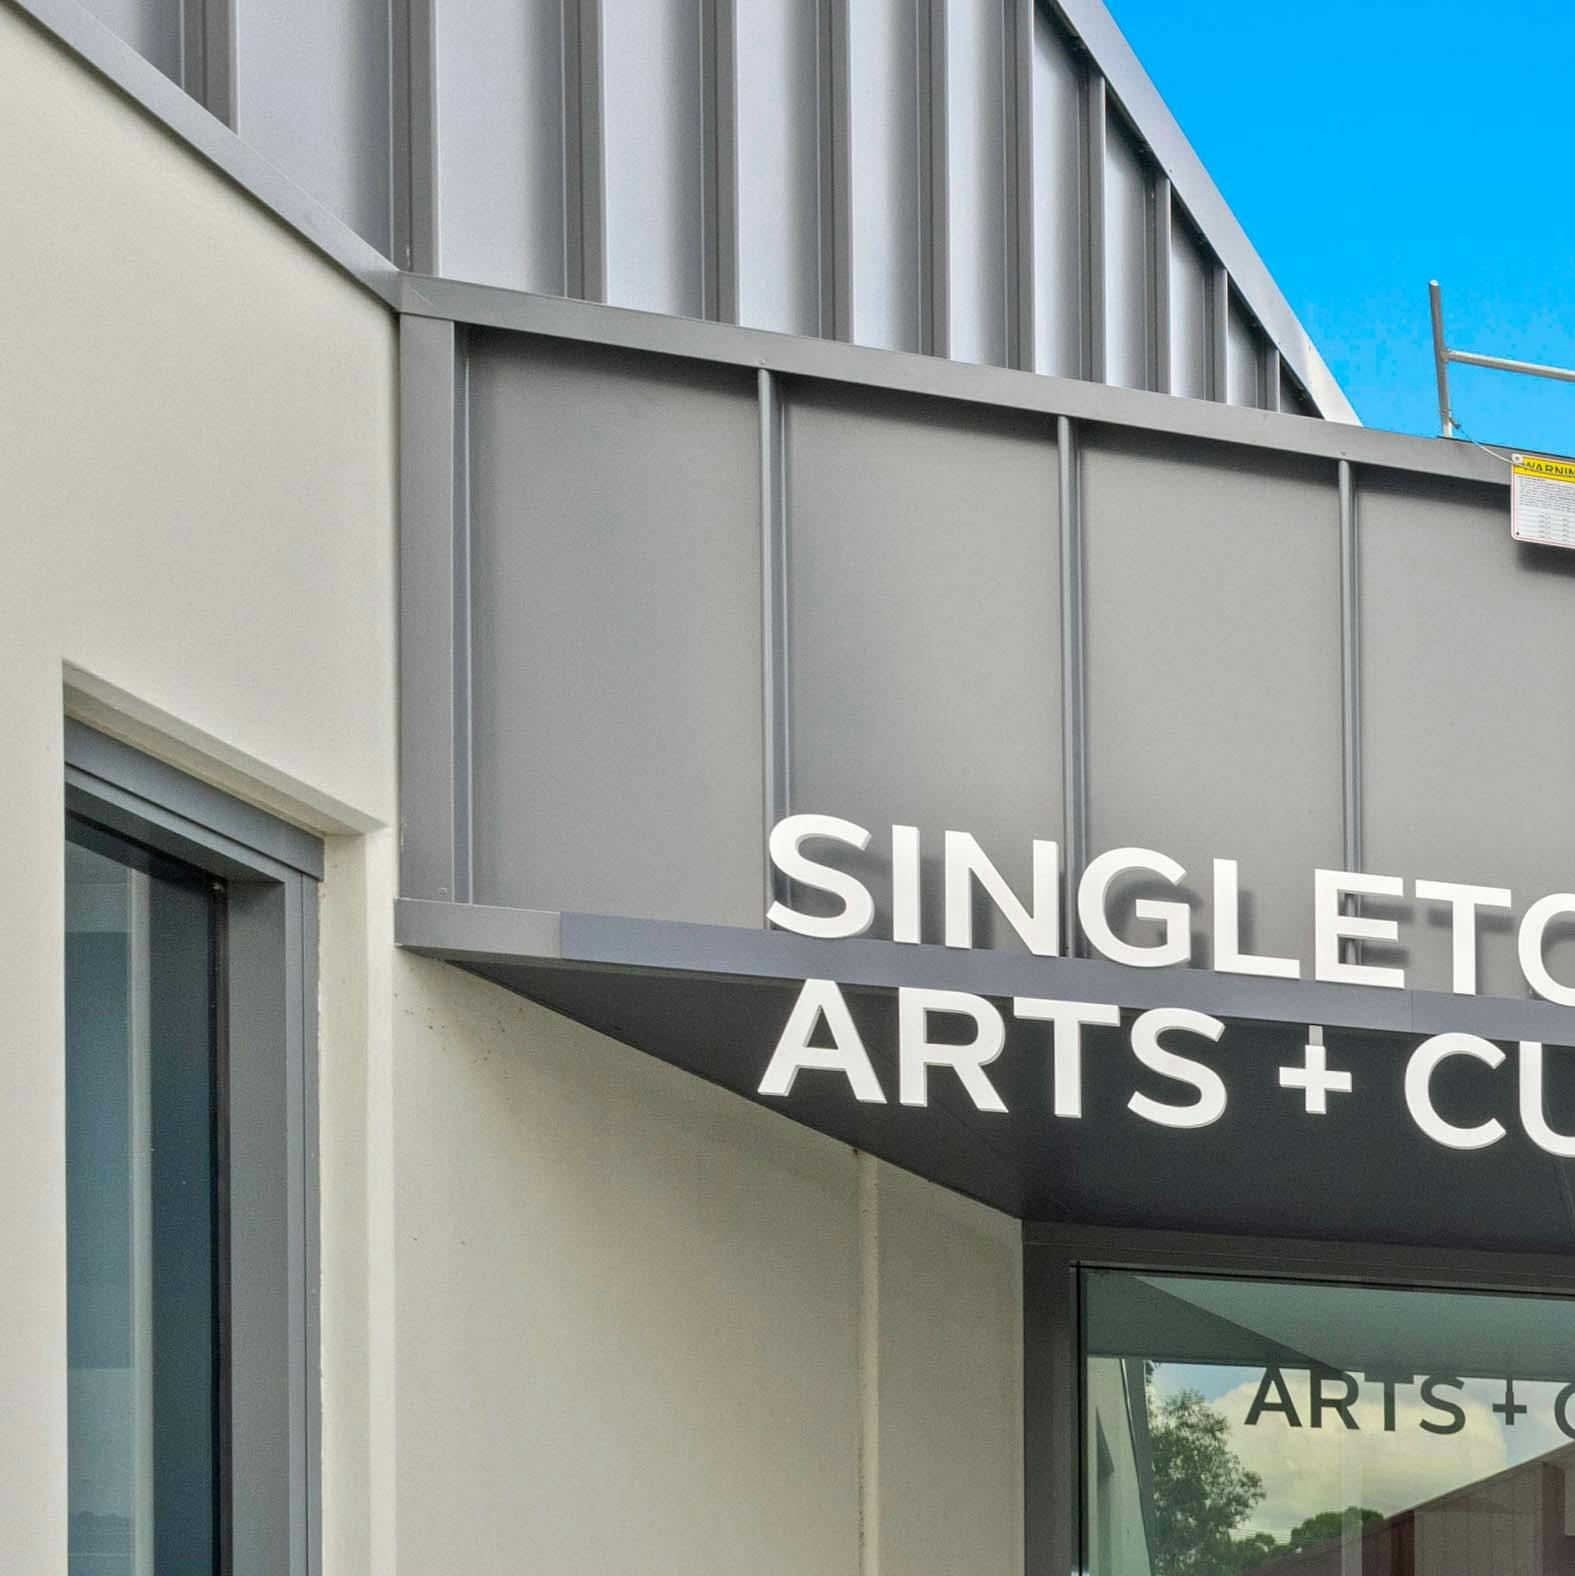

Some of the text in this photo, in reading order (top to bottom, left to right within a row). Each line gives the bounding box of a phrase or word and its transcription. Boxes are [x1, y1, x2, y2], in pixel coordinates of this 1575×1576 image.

[757, 978, 1228, 1128] ARTS
[1278, 1038, 1353, 1115] +
[1244, 1367, 1467, 1435] ARTS
